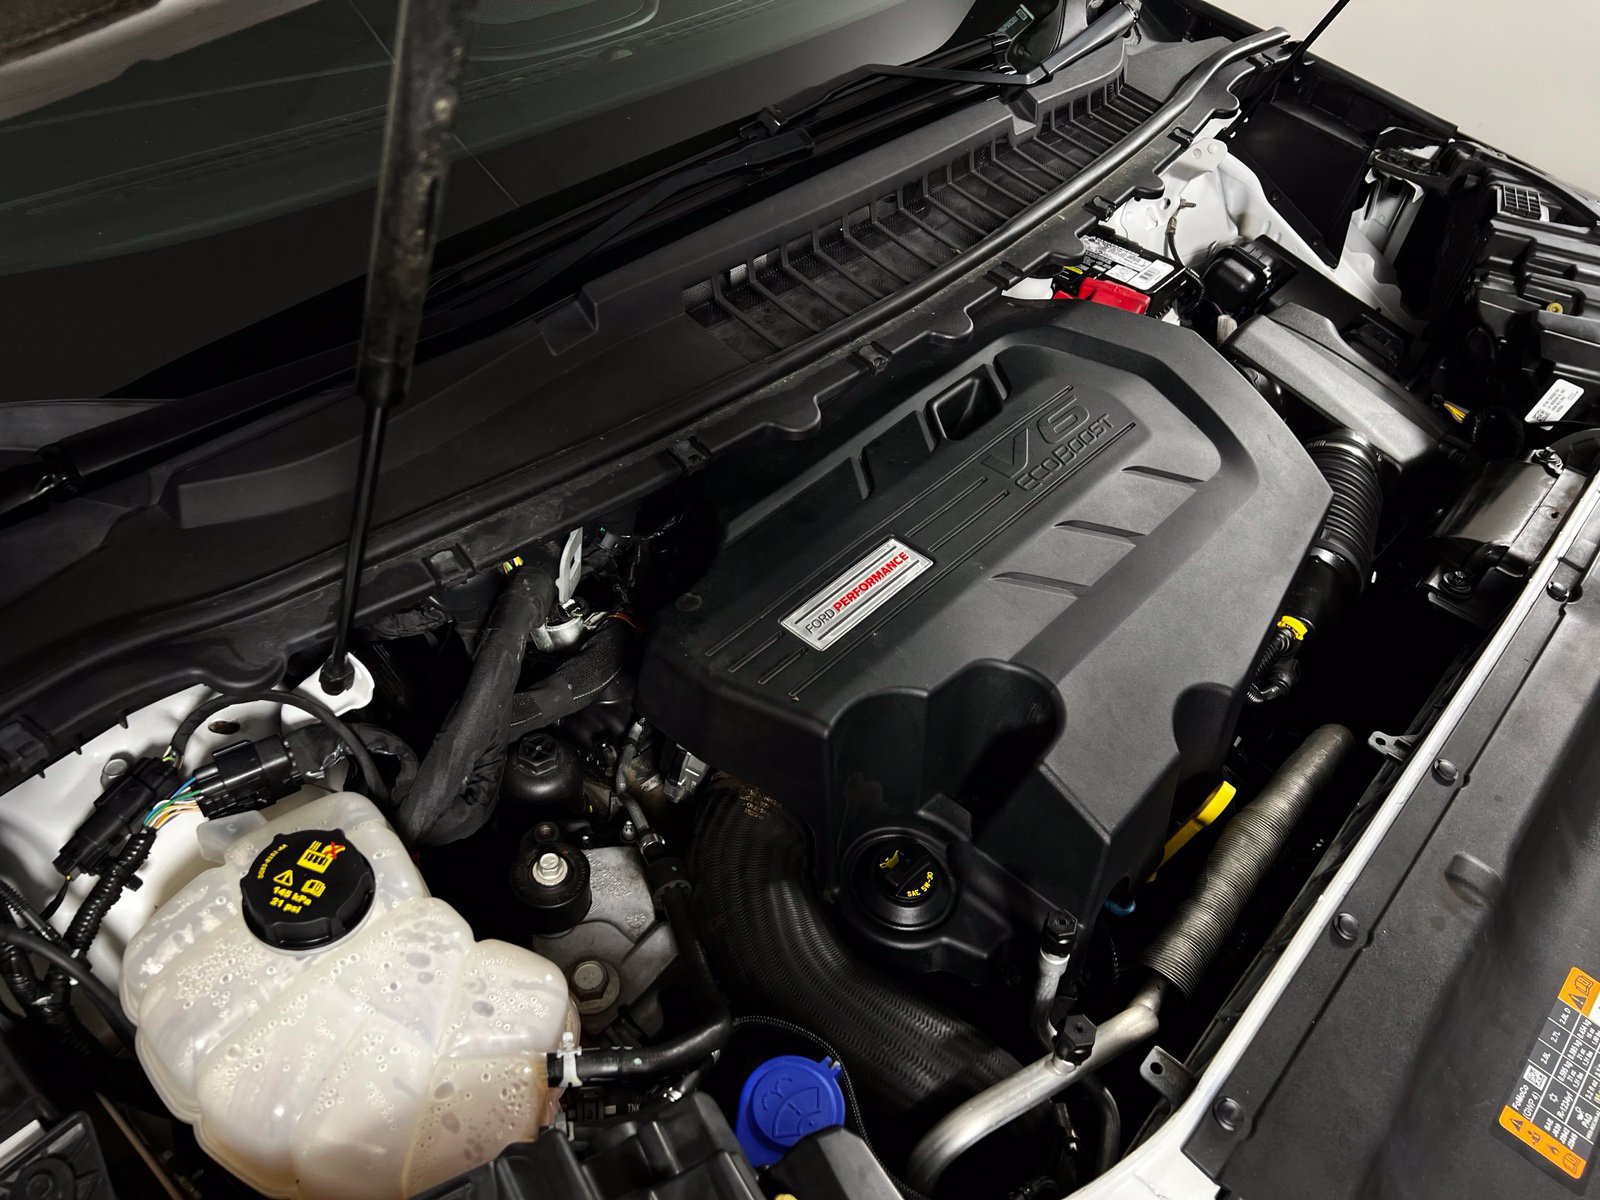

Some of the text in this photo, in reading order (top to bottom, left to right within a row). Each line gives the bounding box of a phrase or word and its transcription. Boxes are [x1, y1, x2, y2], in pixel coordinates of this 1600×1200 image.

[981, 396, 1089, 479] V6
[805, 551, 909, 634] FORD PERFORMANCE
[273, 886, 313, 906] 145 kPa
[907, 889, 921, 898] SAE
[269, 896, 302, 915] 21 psi
[1511, 1084, 1529, 1111] FoMoCo
[1581, 1112, 1593, 1129] PAG
